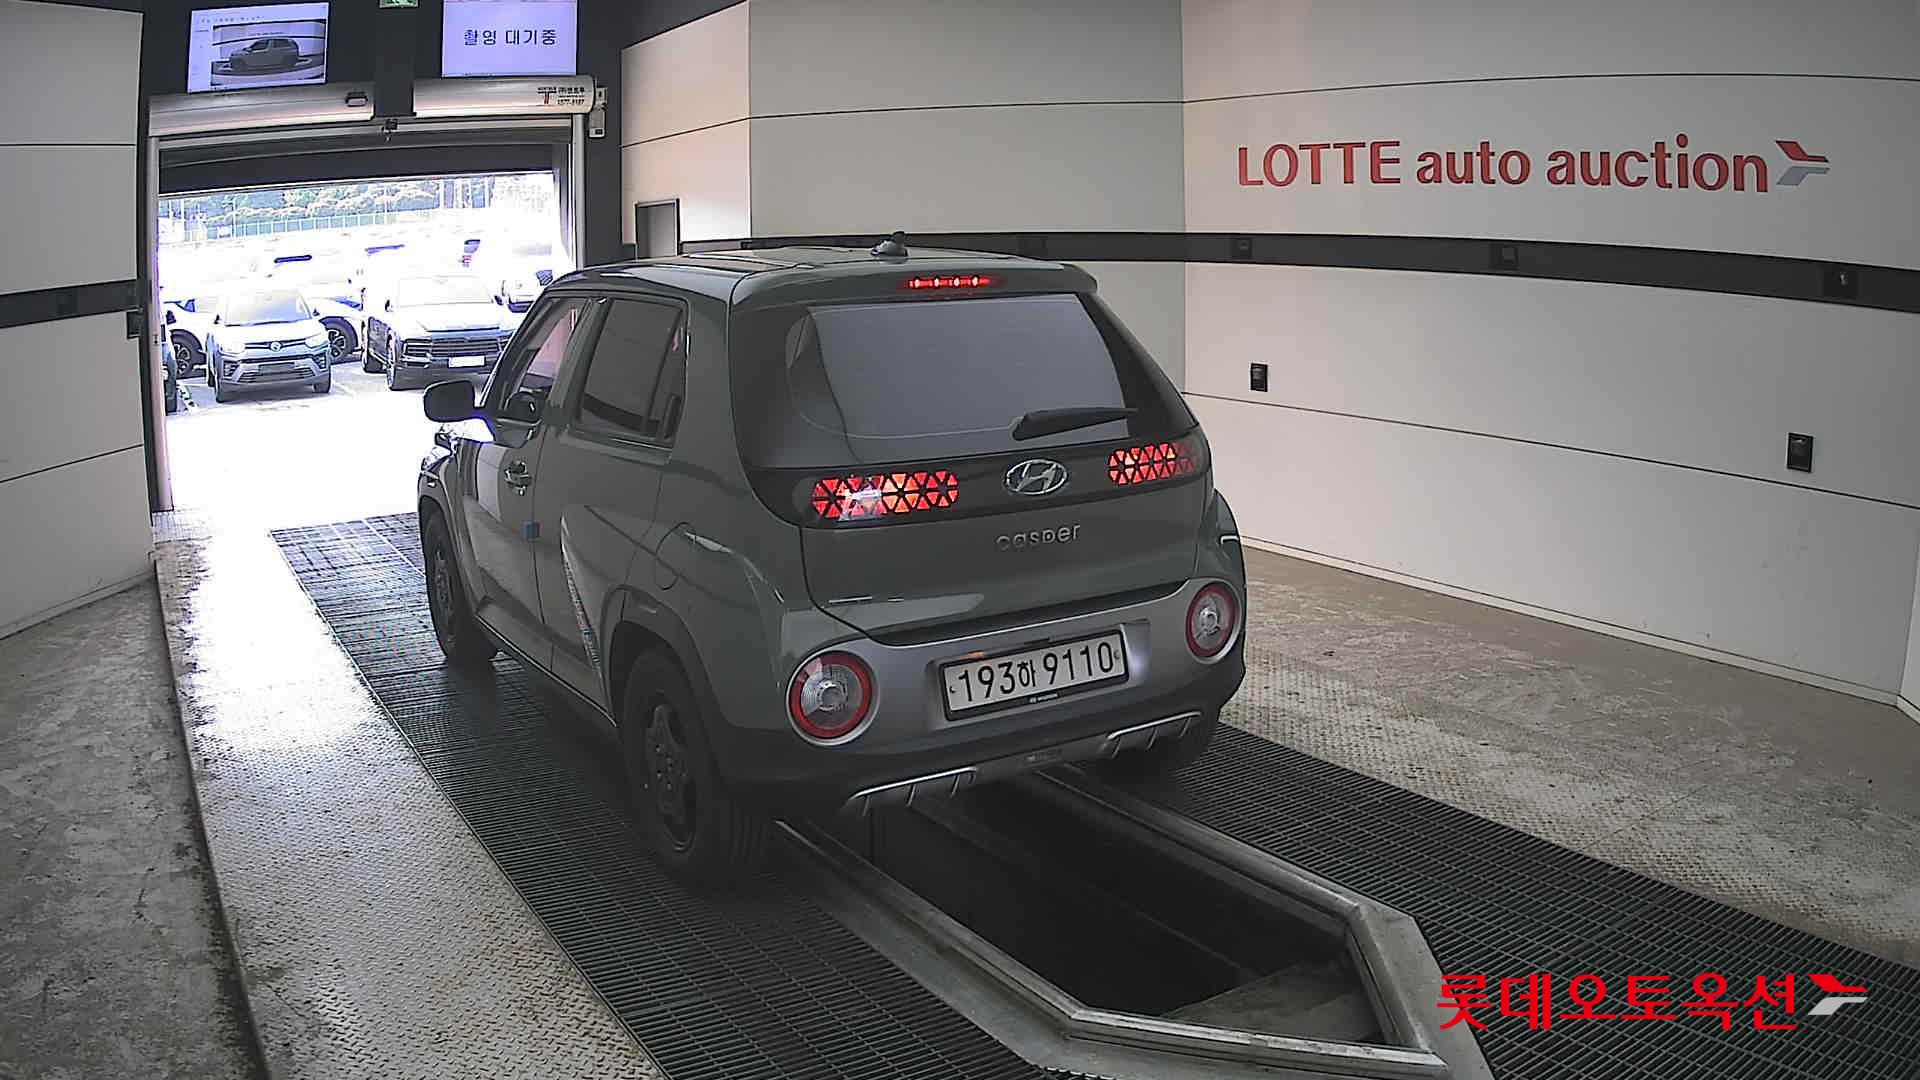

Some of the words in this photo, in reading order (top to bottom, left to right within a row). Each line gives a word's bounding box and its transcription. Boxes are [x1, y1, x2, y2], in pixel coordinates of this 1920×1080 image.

[505, 29, 558, 46] 대기중
[1238, 140, 1400, 187] LOTTE
[1416, 141, 1531, 185] auto
[1547, 133, 1768, 193] auction
[996, 524, 1081, 551] casper
